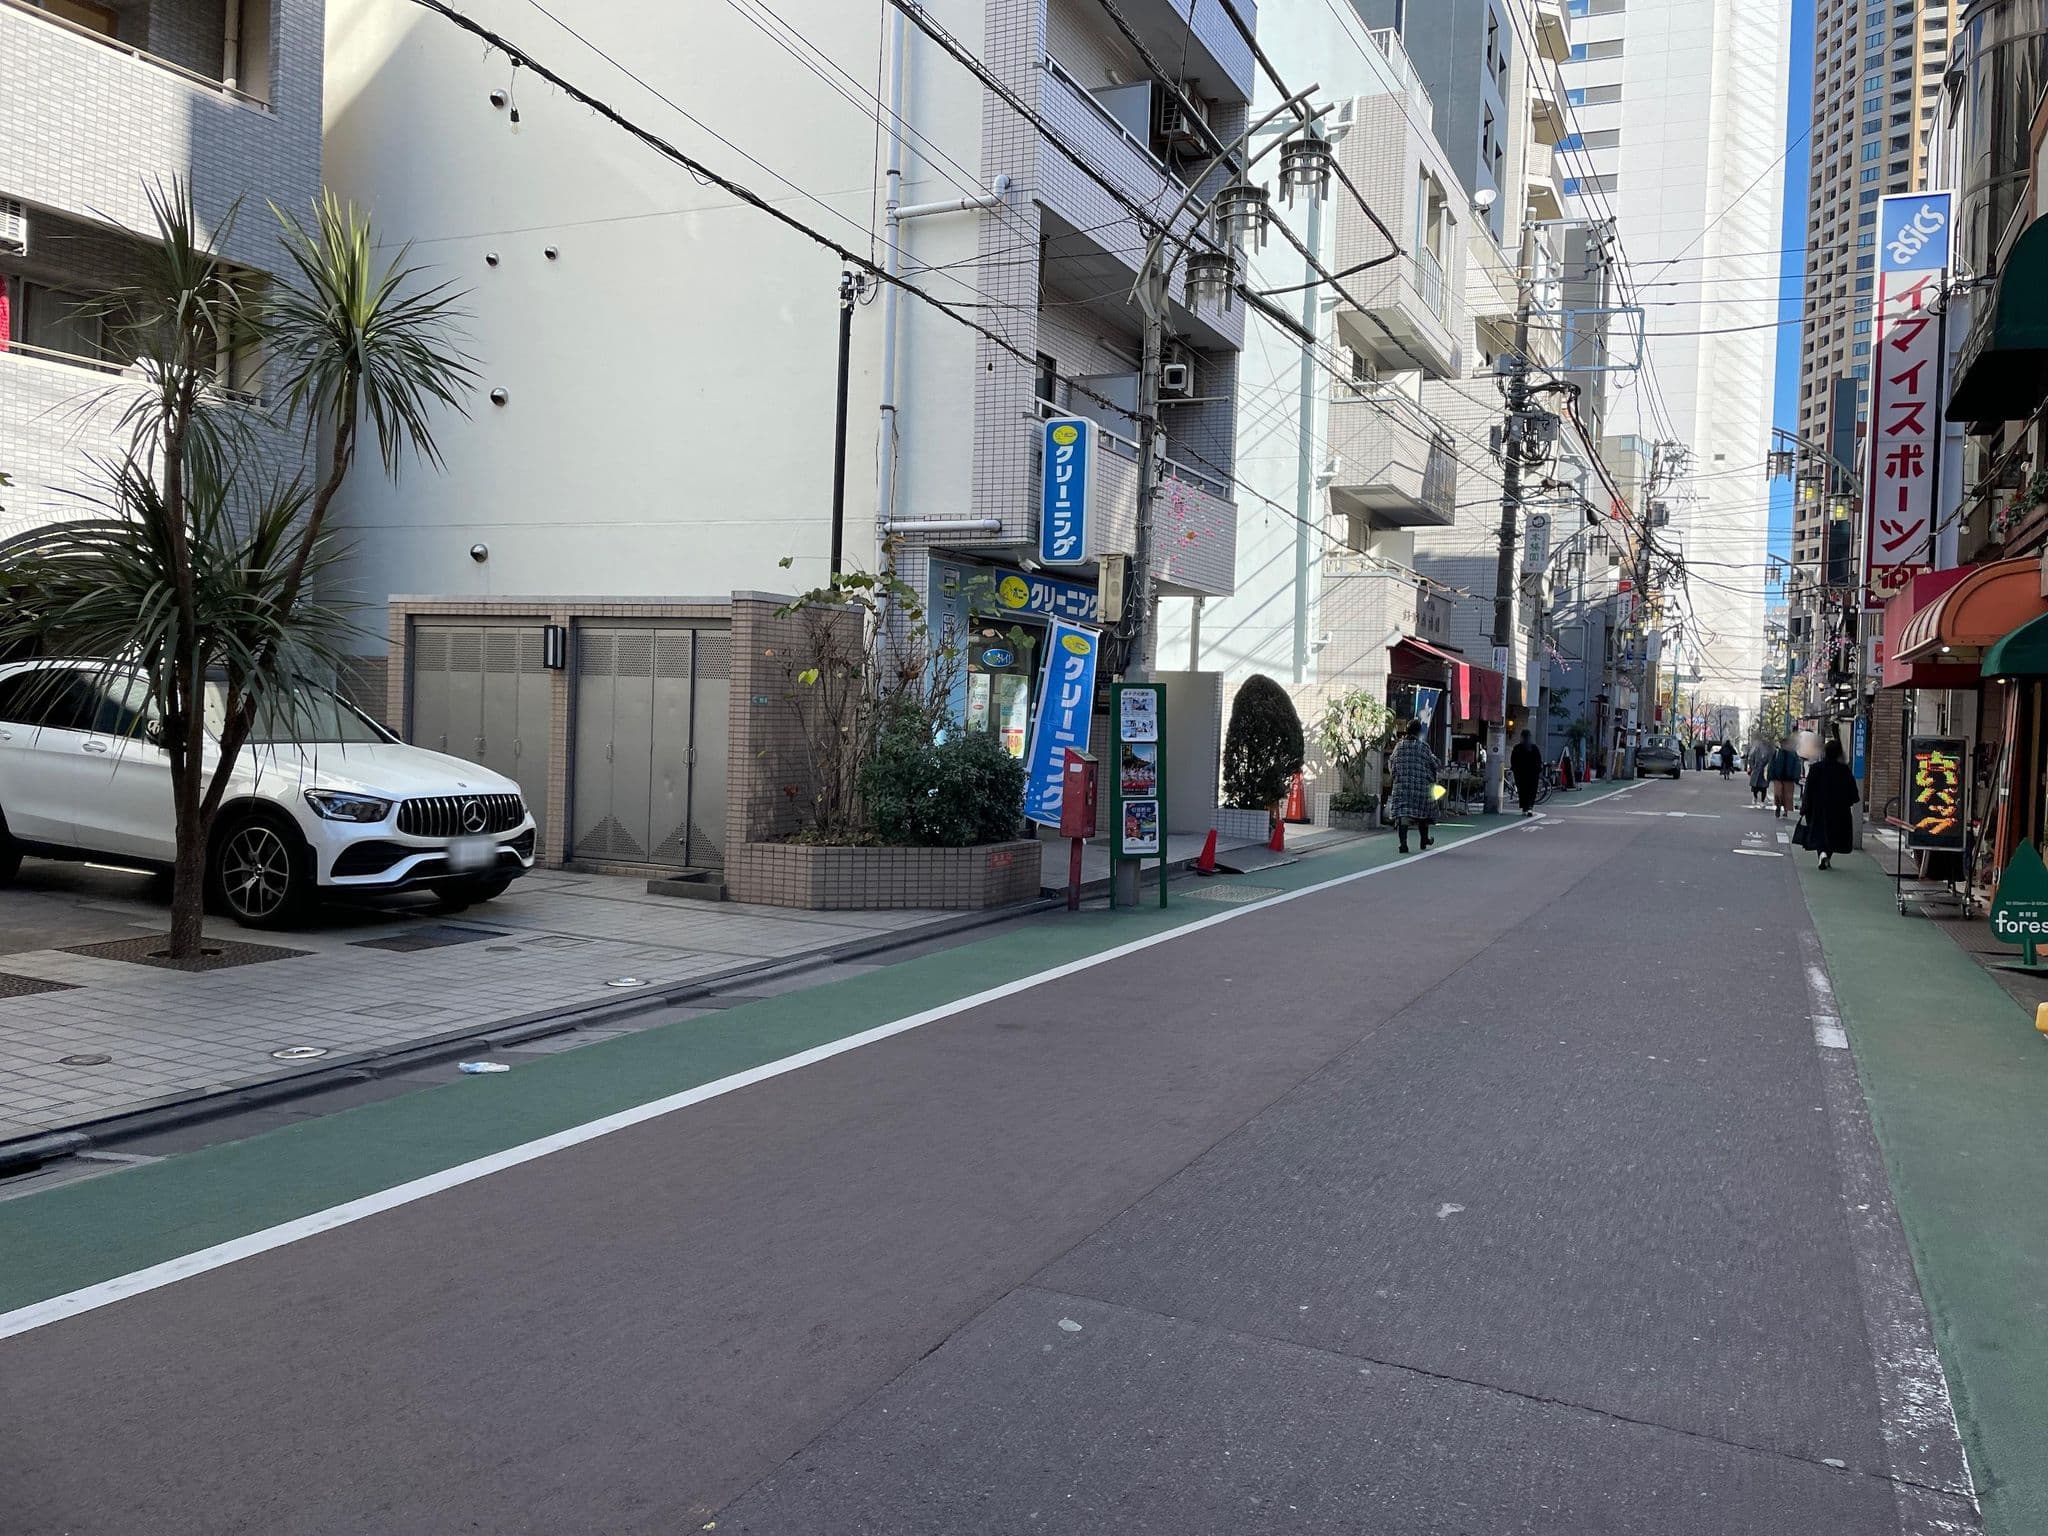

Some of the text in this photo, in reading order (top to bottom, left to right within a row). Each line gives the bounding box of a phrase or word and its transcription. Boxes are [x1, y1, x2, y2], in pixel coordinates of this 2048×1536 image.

[1886, 203, 1945, 265] asics
[1879, 274, 1932, 553] イマイスポーツ
[1053, 445, 1077, 557] クリーニング
